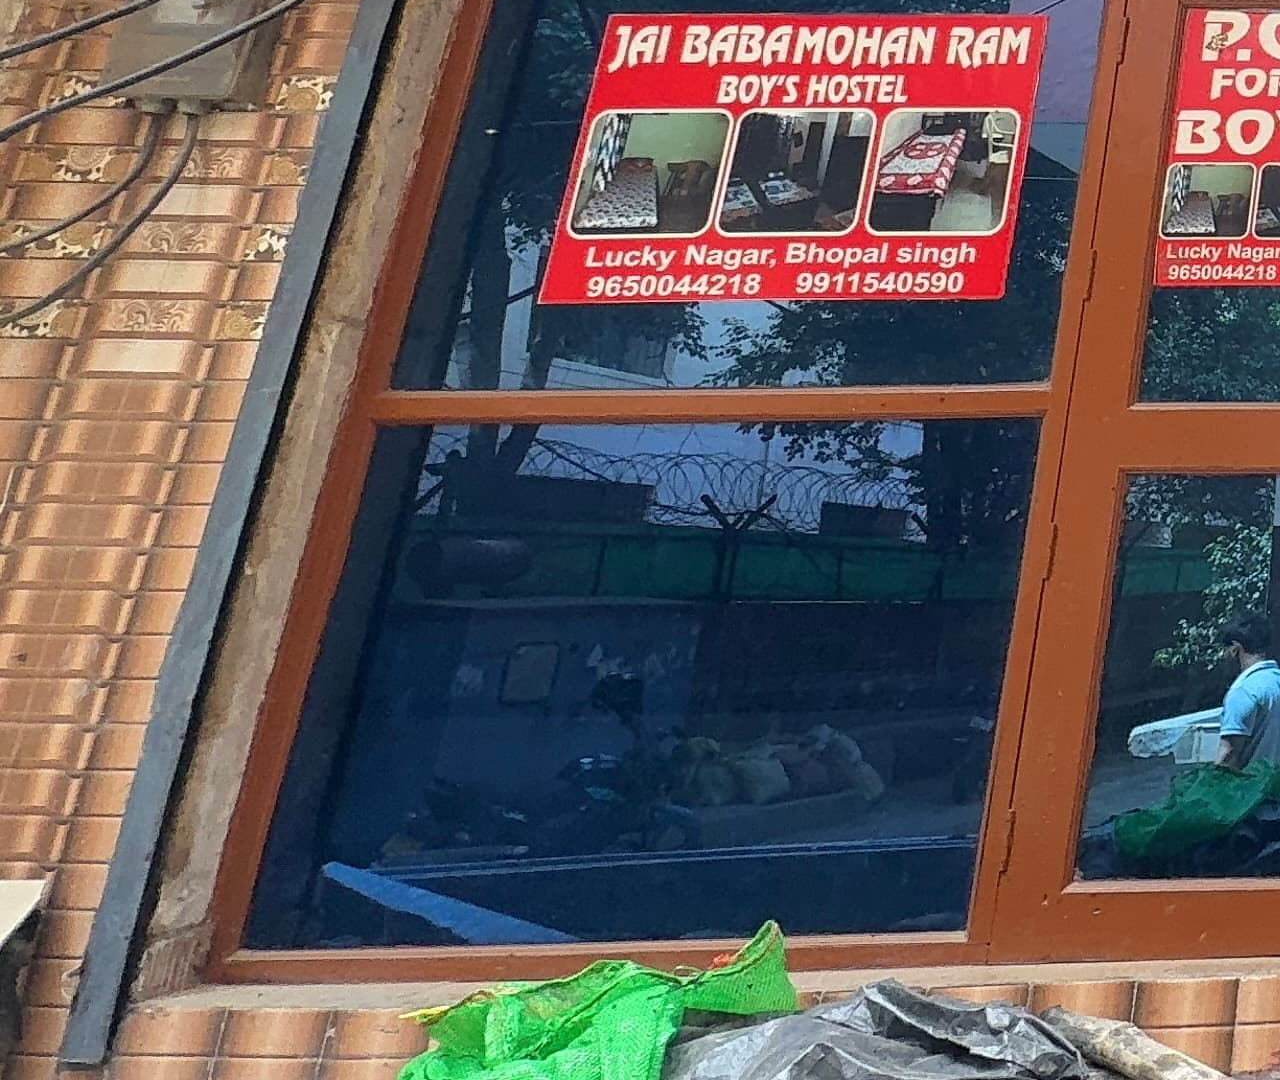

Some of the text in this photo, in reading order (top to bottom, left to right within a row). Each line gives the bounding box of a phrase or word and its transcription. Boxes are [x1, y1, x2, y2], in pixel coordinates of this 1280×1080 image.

[608, 26, 1032, 72] JAI RAM
[717, 74, 908, 106] BOY'S HOSTEL
[586, 243, 977, 272] Lucky Nagar, Bhopal singh
[1166, 243, 1221, 263] Lucky
[587, 272, 965, 298] 9650044218 9911540590
[1167, 265, 1278, 281] 9650044218
